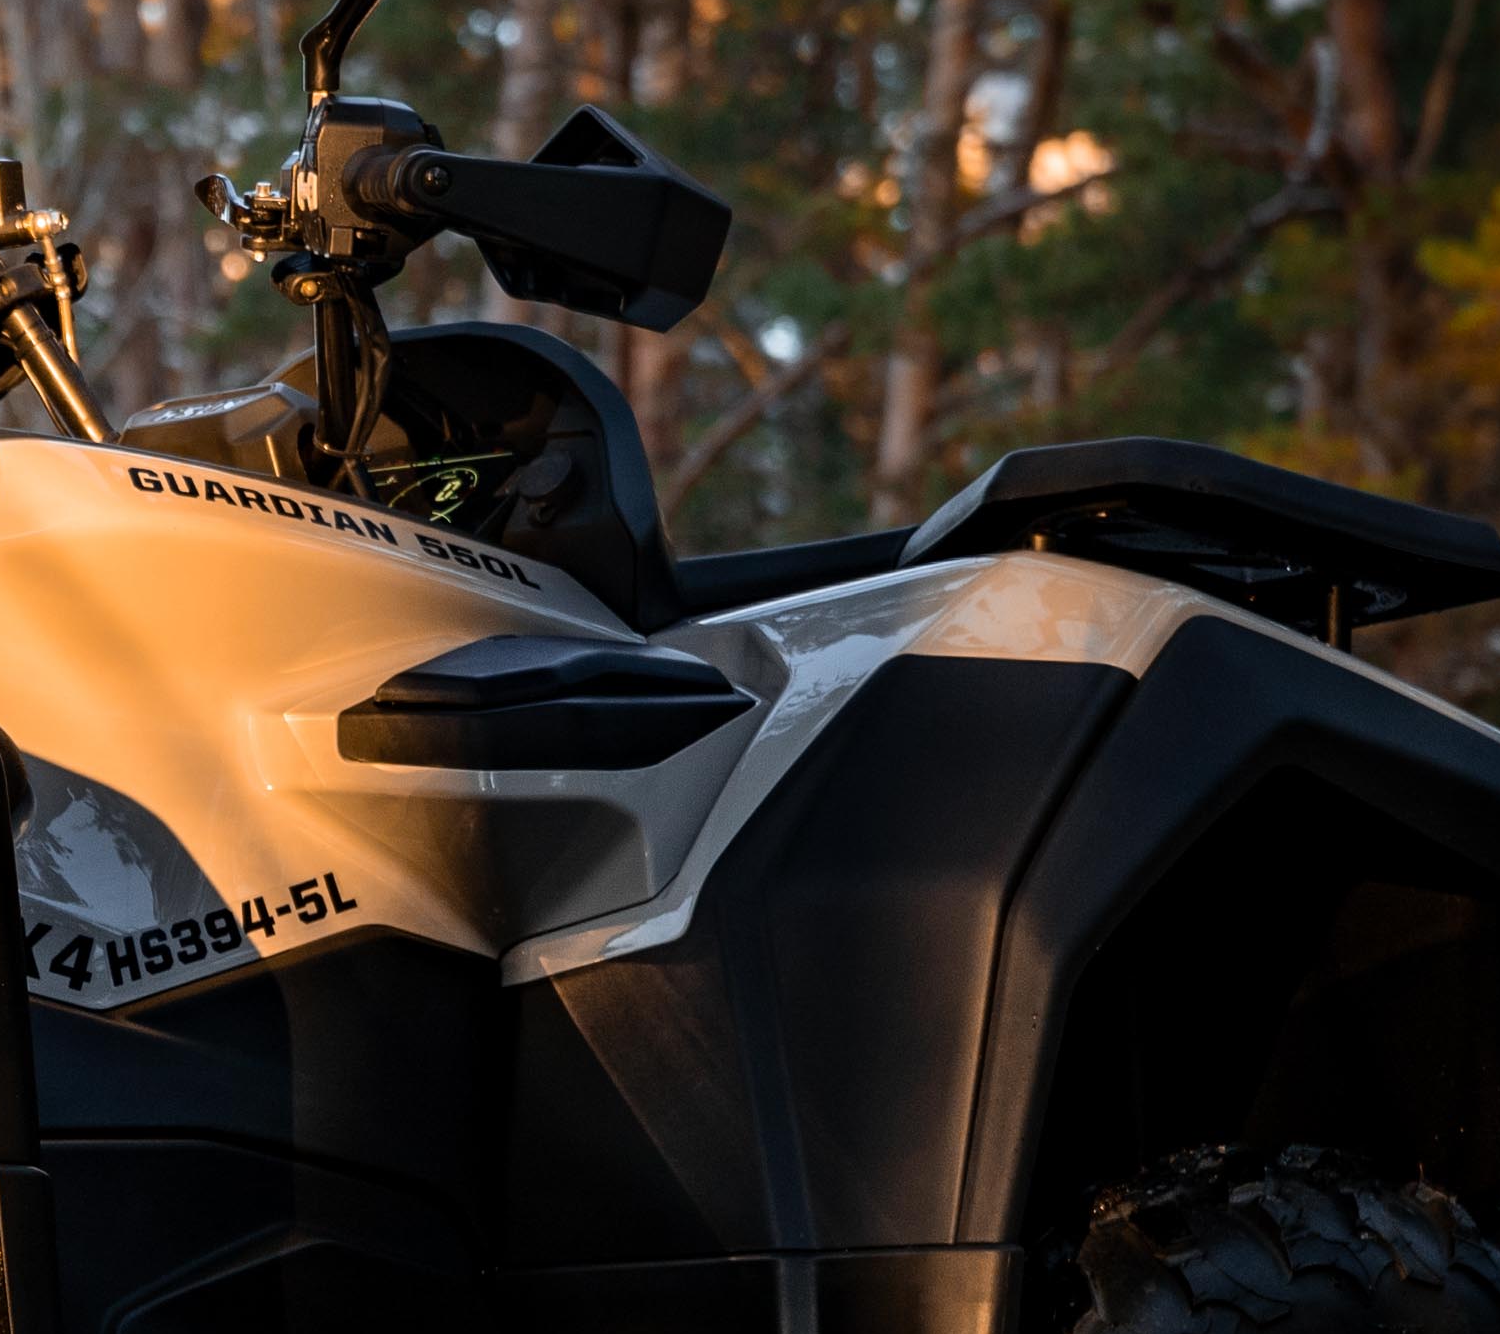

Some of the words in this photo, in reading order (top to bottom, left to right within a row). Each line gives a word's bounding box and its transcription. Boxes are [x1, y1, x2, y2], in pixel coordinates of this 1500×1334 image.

[129, 466, 399, 546] GUARDIAN
[415, 532, 541, 590] 550L
[106, 873, 358, 987] HS394-5L
